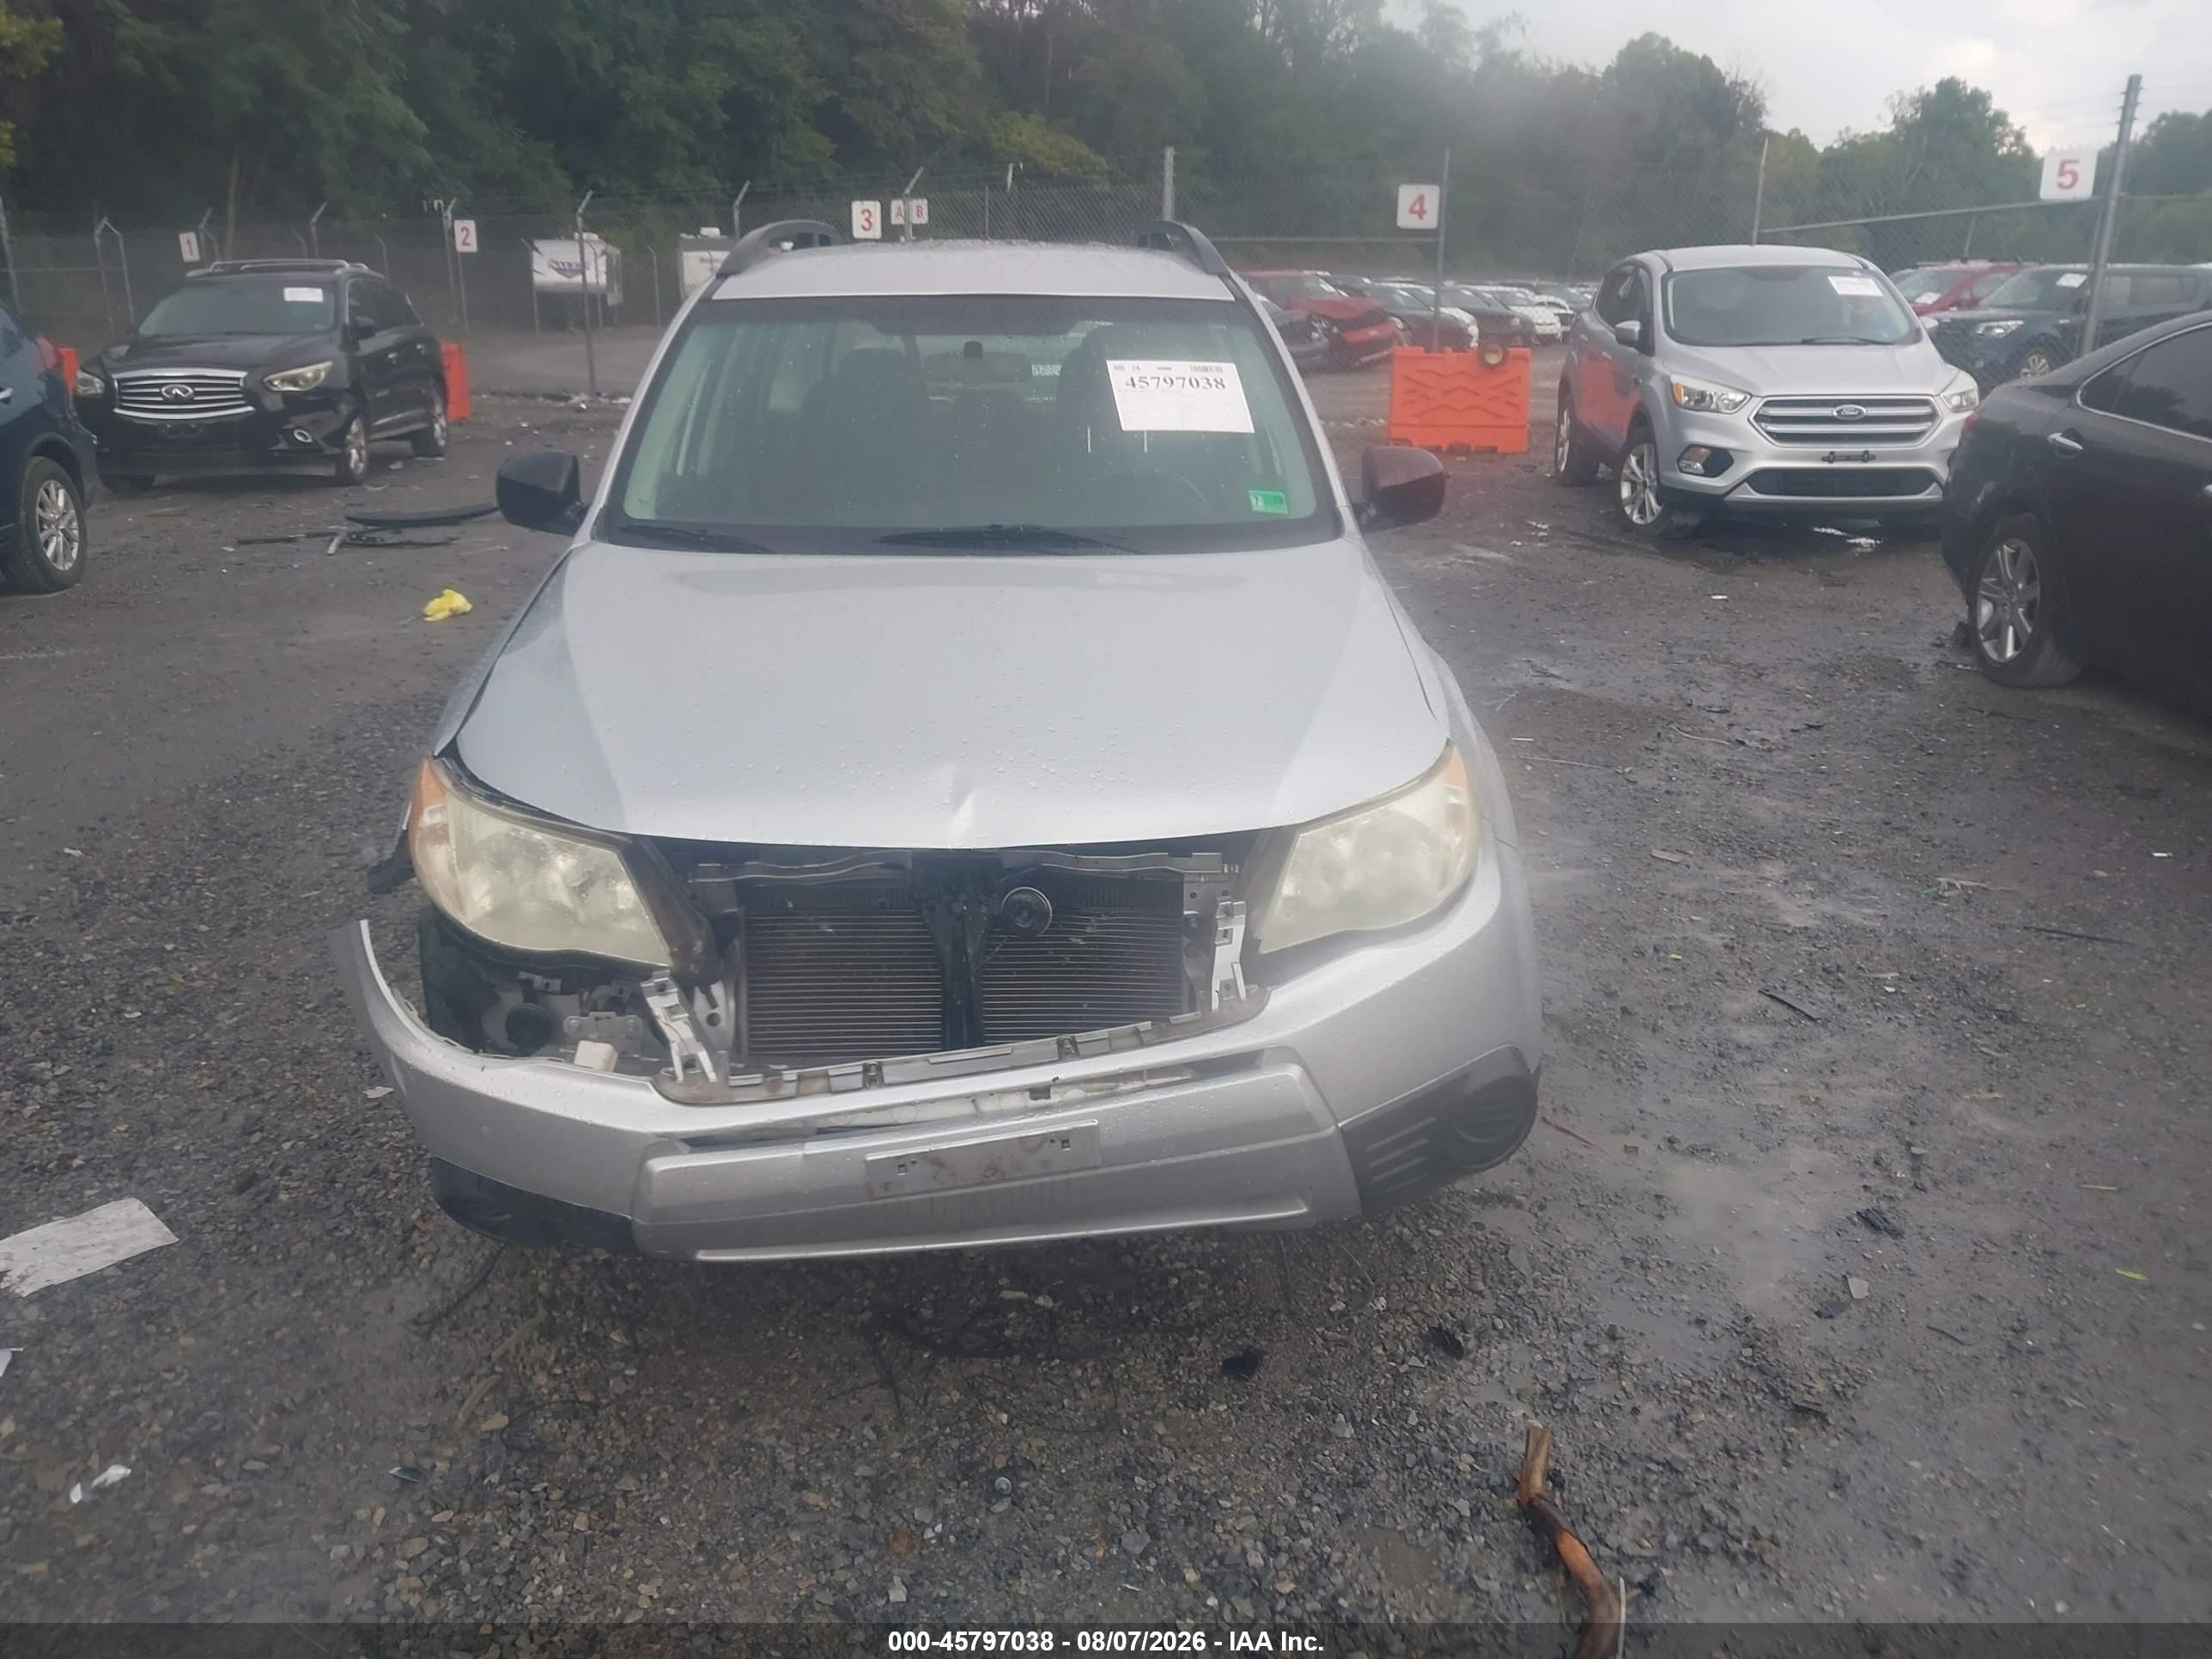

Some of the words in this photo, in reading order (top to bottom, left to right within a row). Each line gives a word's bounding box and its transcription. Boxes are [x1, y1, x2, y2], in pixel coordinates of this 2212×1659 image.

[2057, 158, 2080, 190] 5
[896, 206, 905, 220] A
[915, 204, 924, 218] B
[1408, 193, 1427, 221] 4
[861, 208, 872, 232] 3
[460, 226, 471, 246] 2
[185, 239, 193, 256] 1
[1125, 375, 1226, 390] 45797038
